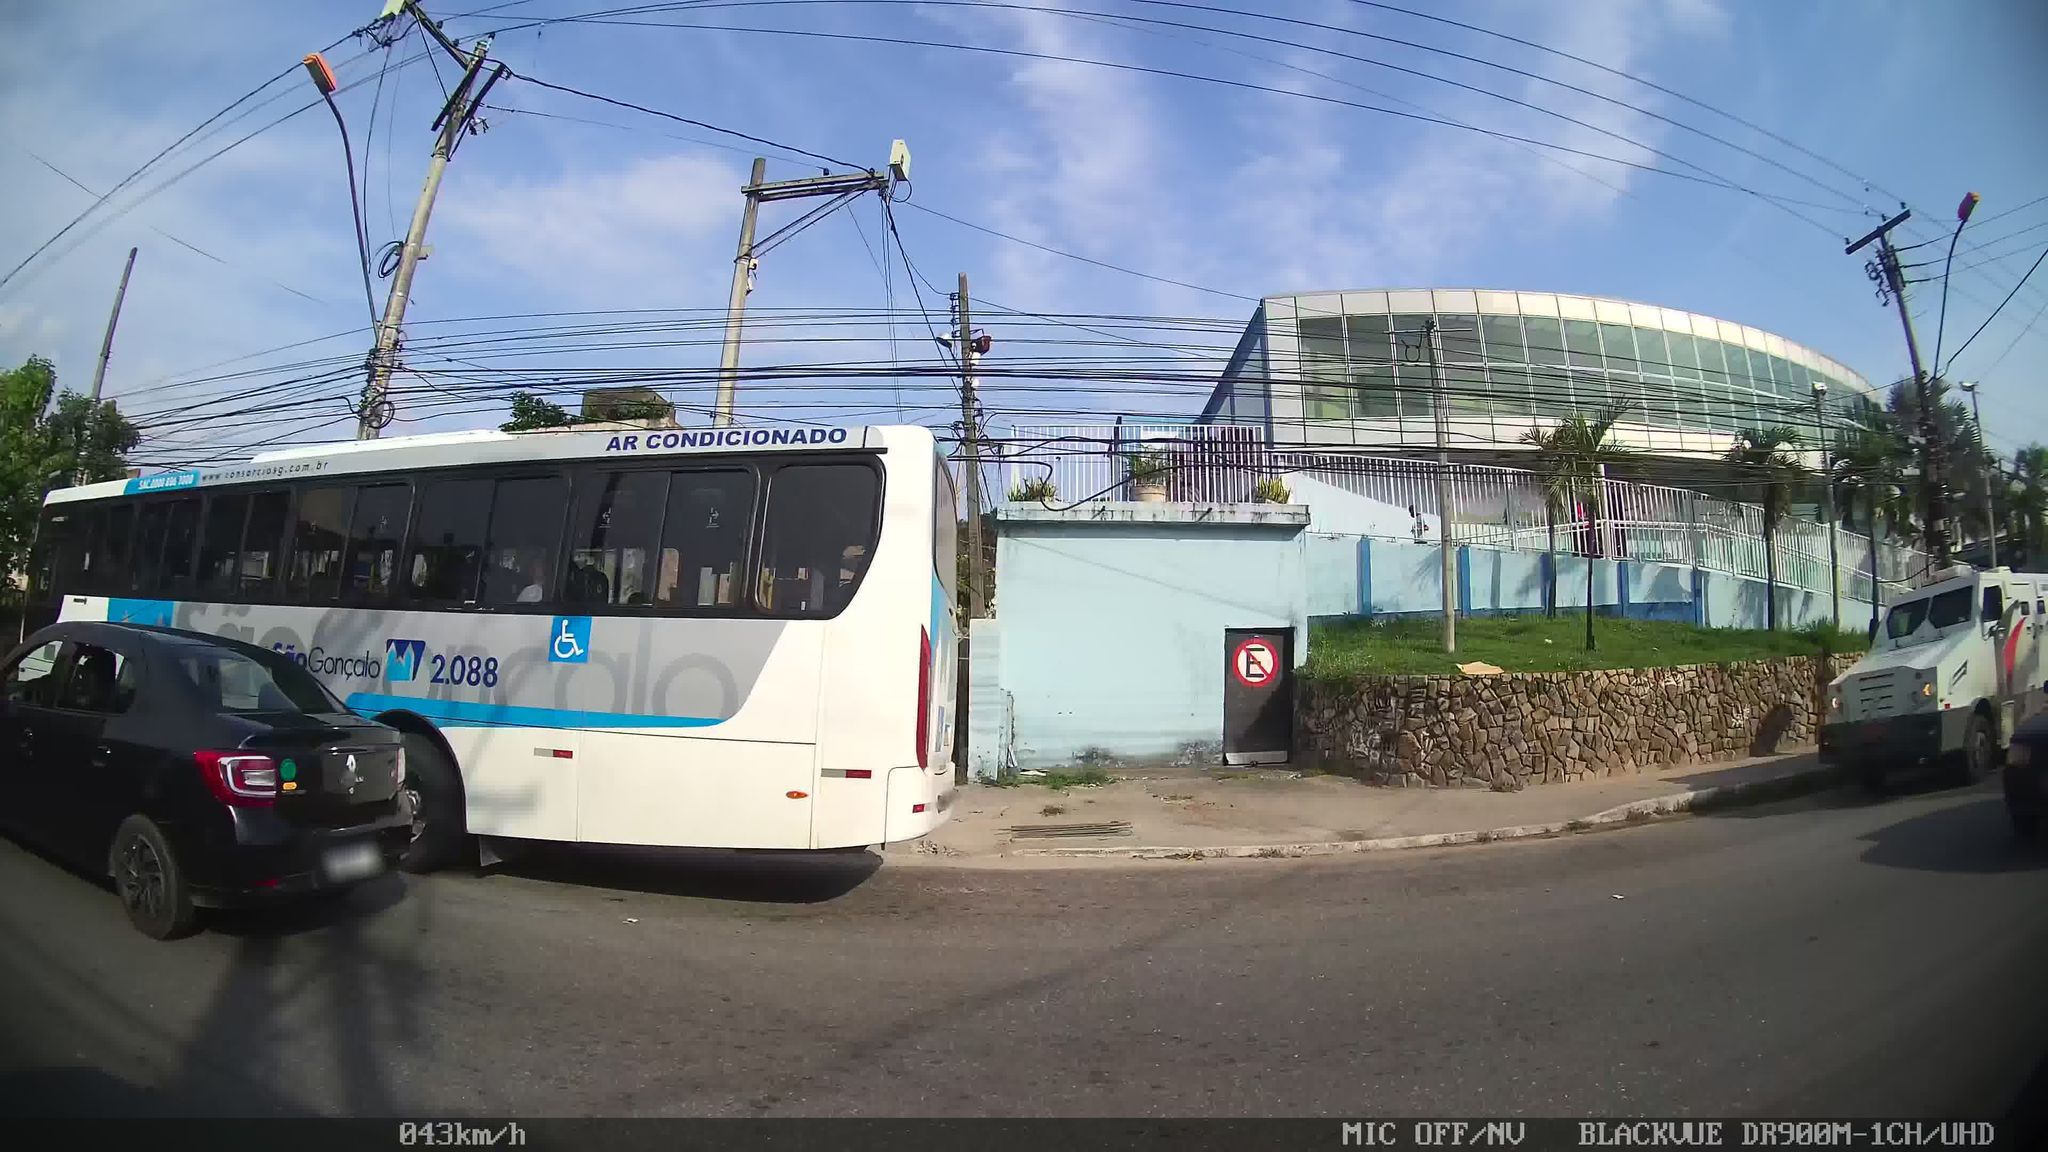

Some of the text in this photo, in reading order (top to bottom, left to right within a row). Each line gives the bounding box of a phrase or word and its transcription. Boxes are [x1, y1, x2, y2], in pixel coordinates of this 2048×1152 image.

[605, 428, 848, 451] AR CONDICIONADO
[430, 654, 499, 688] 2.088
[1245, 647, 1265, 678] E
